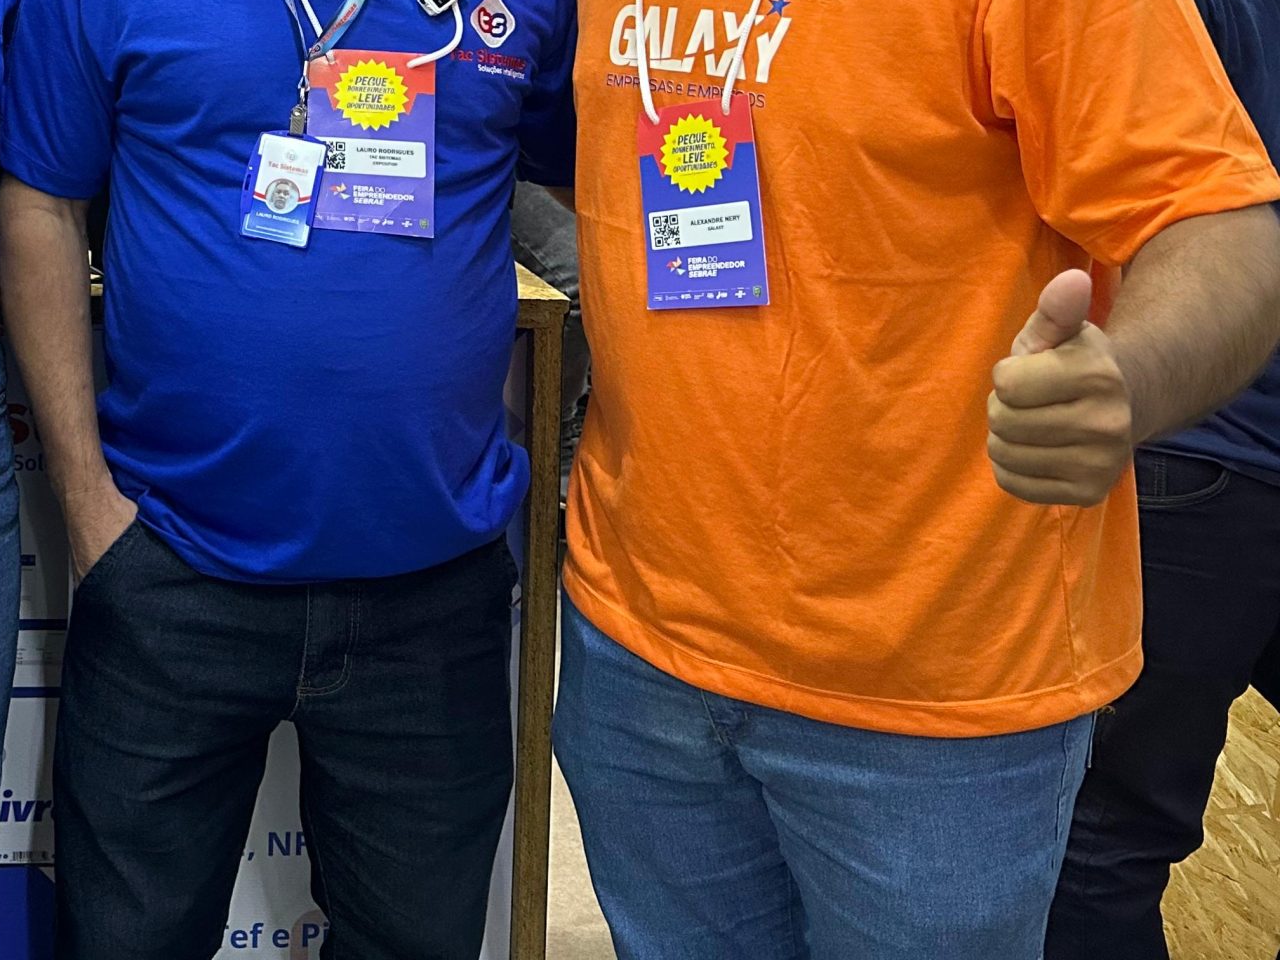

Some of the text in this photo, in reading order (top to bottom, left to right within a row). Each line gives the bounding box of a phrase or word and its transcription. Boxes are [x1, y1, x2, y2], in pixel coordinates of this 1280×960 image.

[609, 4, 792, 84] GALAXY
[606, 73, 674, 93] EMPRSAS
[687, 84, 765, 108] EMPOS
[358, 93, 384, 103] LEVE
[683, 151, 705, 164] LEVE
[353, 185, 374, 193] FEIRA
[353, 191, 414, 201] EMPREENDEDOR
[690, 217, 723, 226] ALEXANDRE
[688, 261, 745, 271] EMPREENDEDOR
[688, 270, 717, 278] SEBRAE
[225, 922, 264, 948] ef
[272, 929, 290, 948] e
